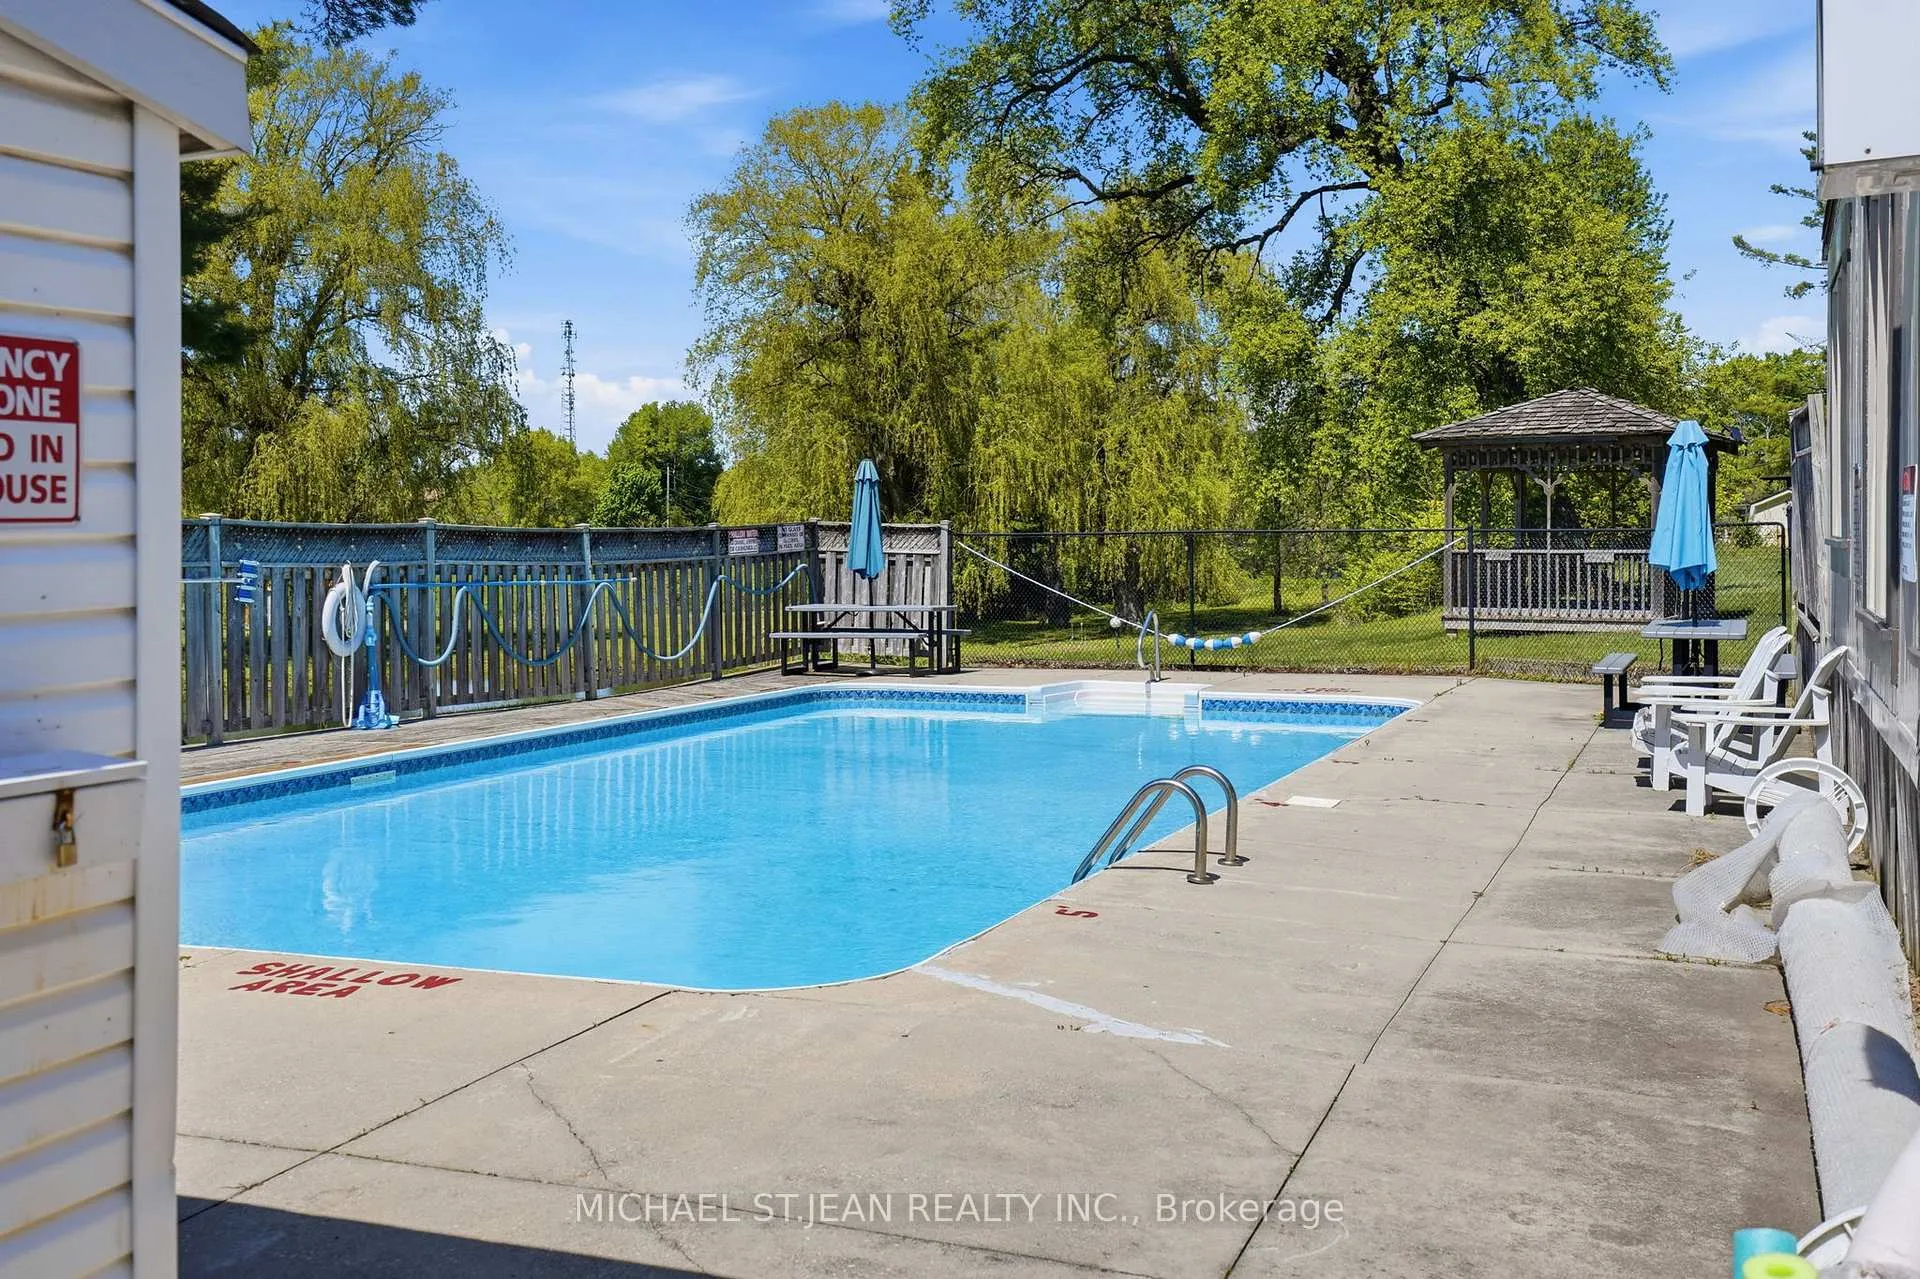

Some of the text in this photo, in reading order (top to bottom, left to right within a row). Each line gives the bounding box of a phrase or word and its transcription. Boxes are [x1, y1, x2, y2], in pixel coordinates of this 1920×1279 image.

[0, 346, 71, 382] NCY
[31, 434, 63, 463] IN
[0, 474, 67, 503] USE
[228, 979, 361, 998] AREA
[236, 962, 462, 989] SHALLOW
